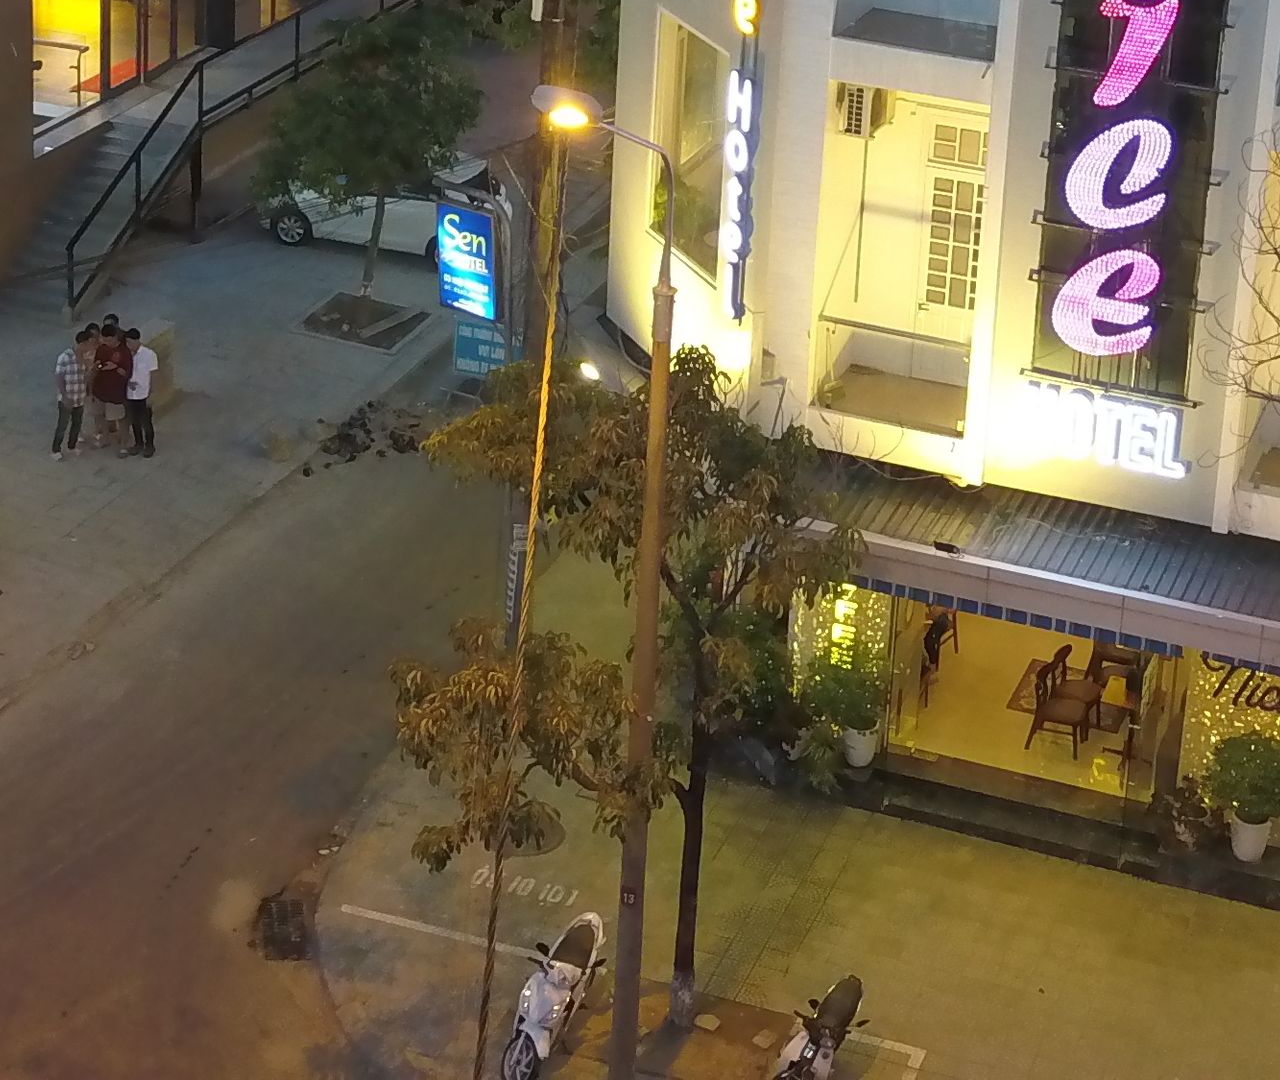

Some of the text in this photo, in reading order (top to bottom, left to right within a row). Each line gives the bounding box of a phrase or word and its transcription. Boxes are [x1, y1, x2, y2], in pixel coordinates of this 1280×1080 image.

[443, 213, 487, 257] Sen
[442, 251, 489, 274] TEL
[623, 892, 636, 905] 13
